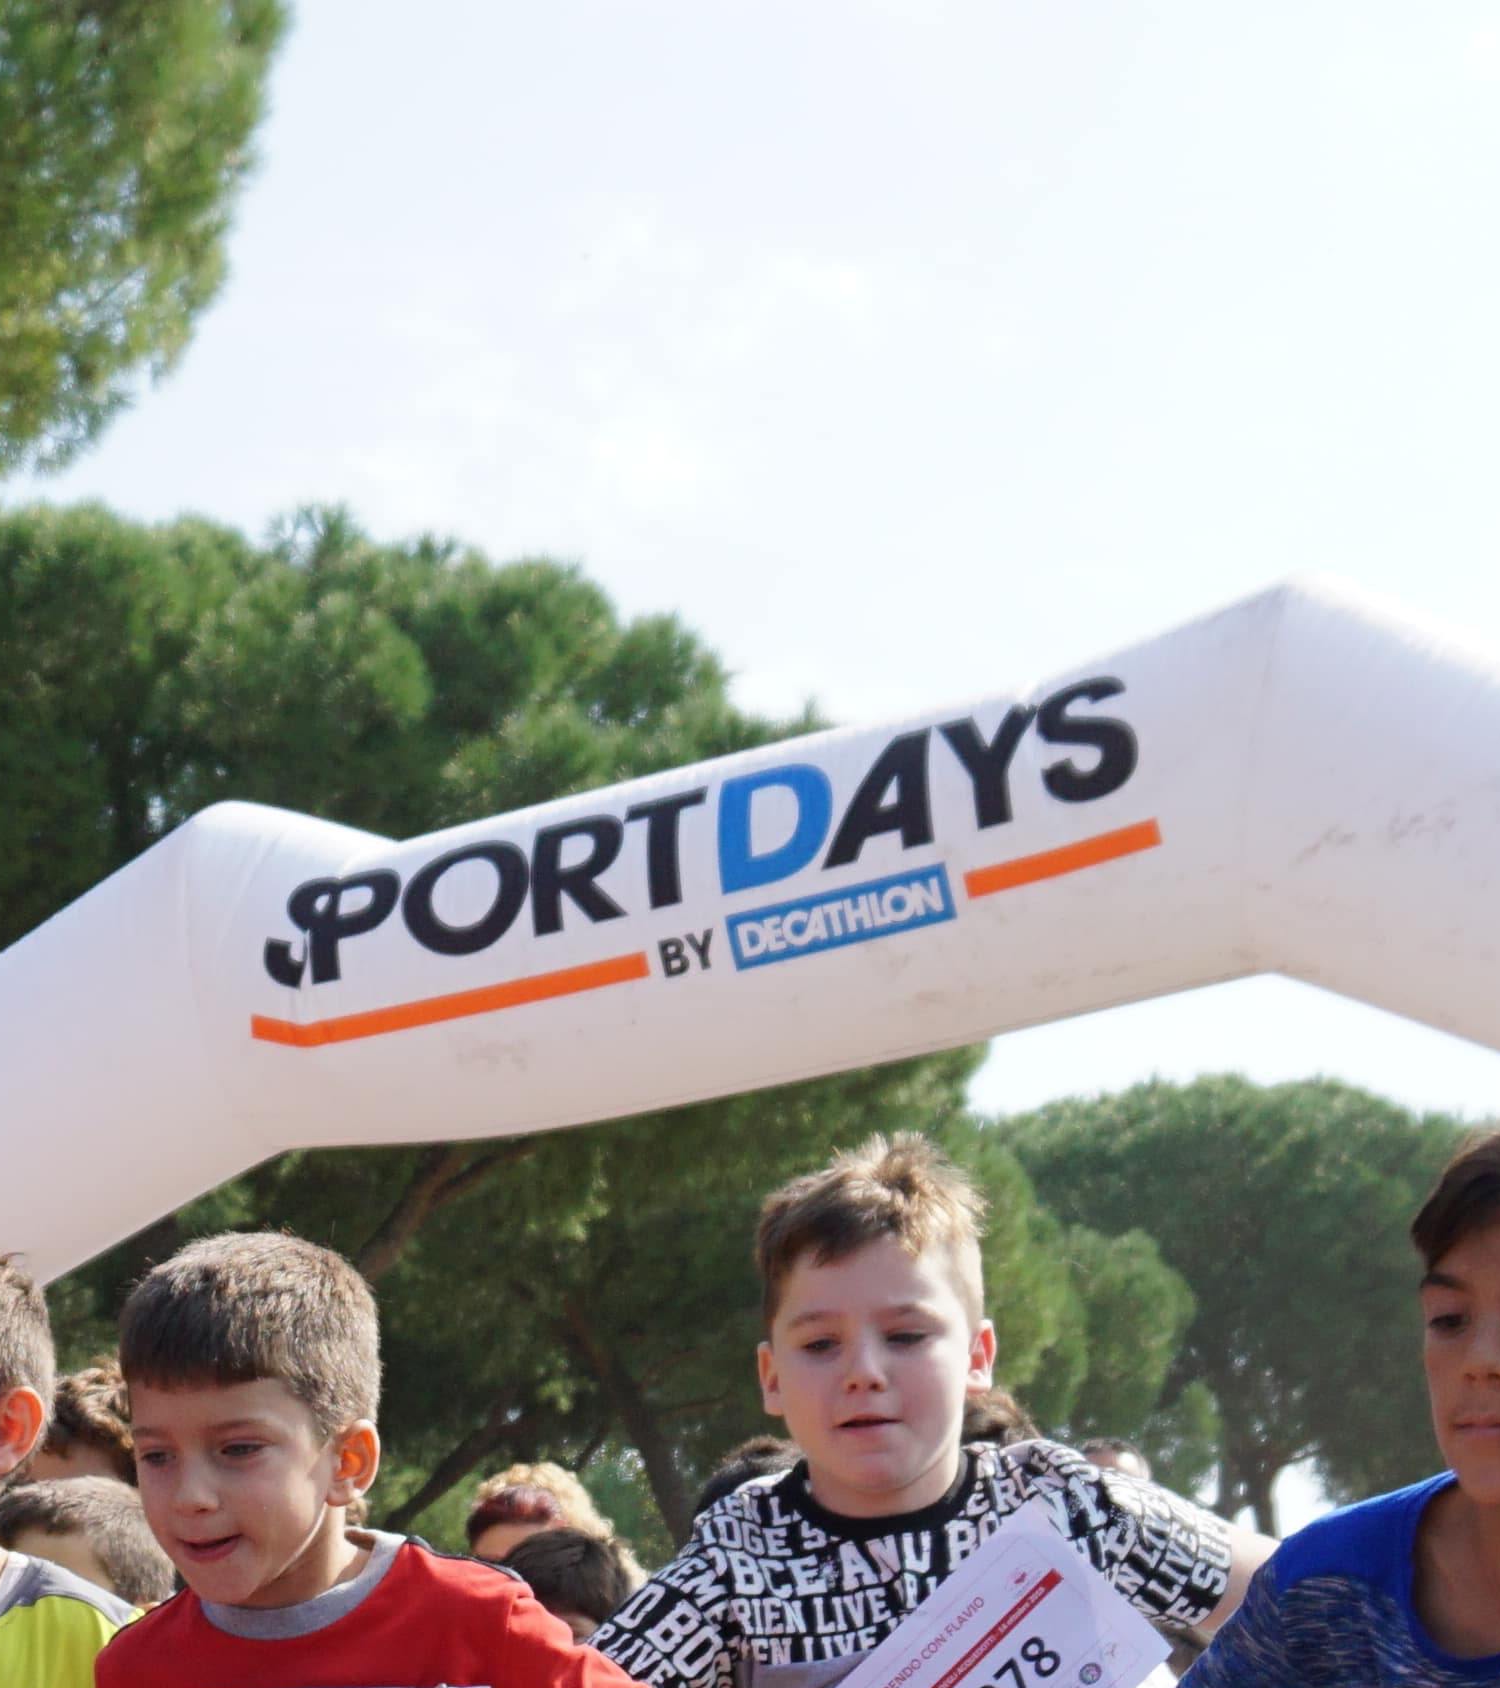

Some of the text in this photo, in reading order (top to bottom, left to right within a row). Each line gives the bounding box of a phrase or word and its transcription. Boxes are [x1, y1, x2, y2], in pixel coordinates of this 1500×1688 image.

[264, 675, 1138, 990] SPORTDAYS
[657, 875, 945, 979] BY DECATHLON
[813, 1587, 891, 1635] LIVE
[920, 1633, 947, 1660] CON
[944, 1596, 985, 1637] FLAVIO
